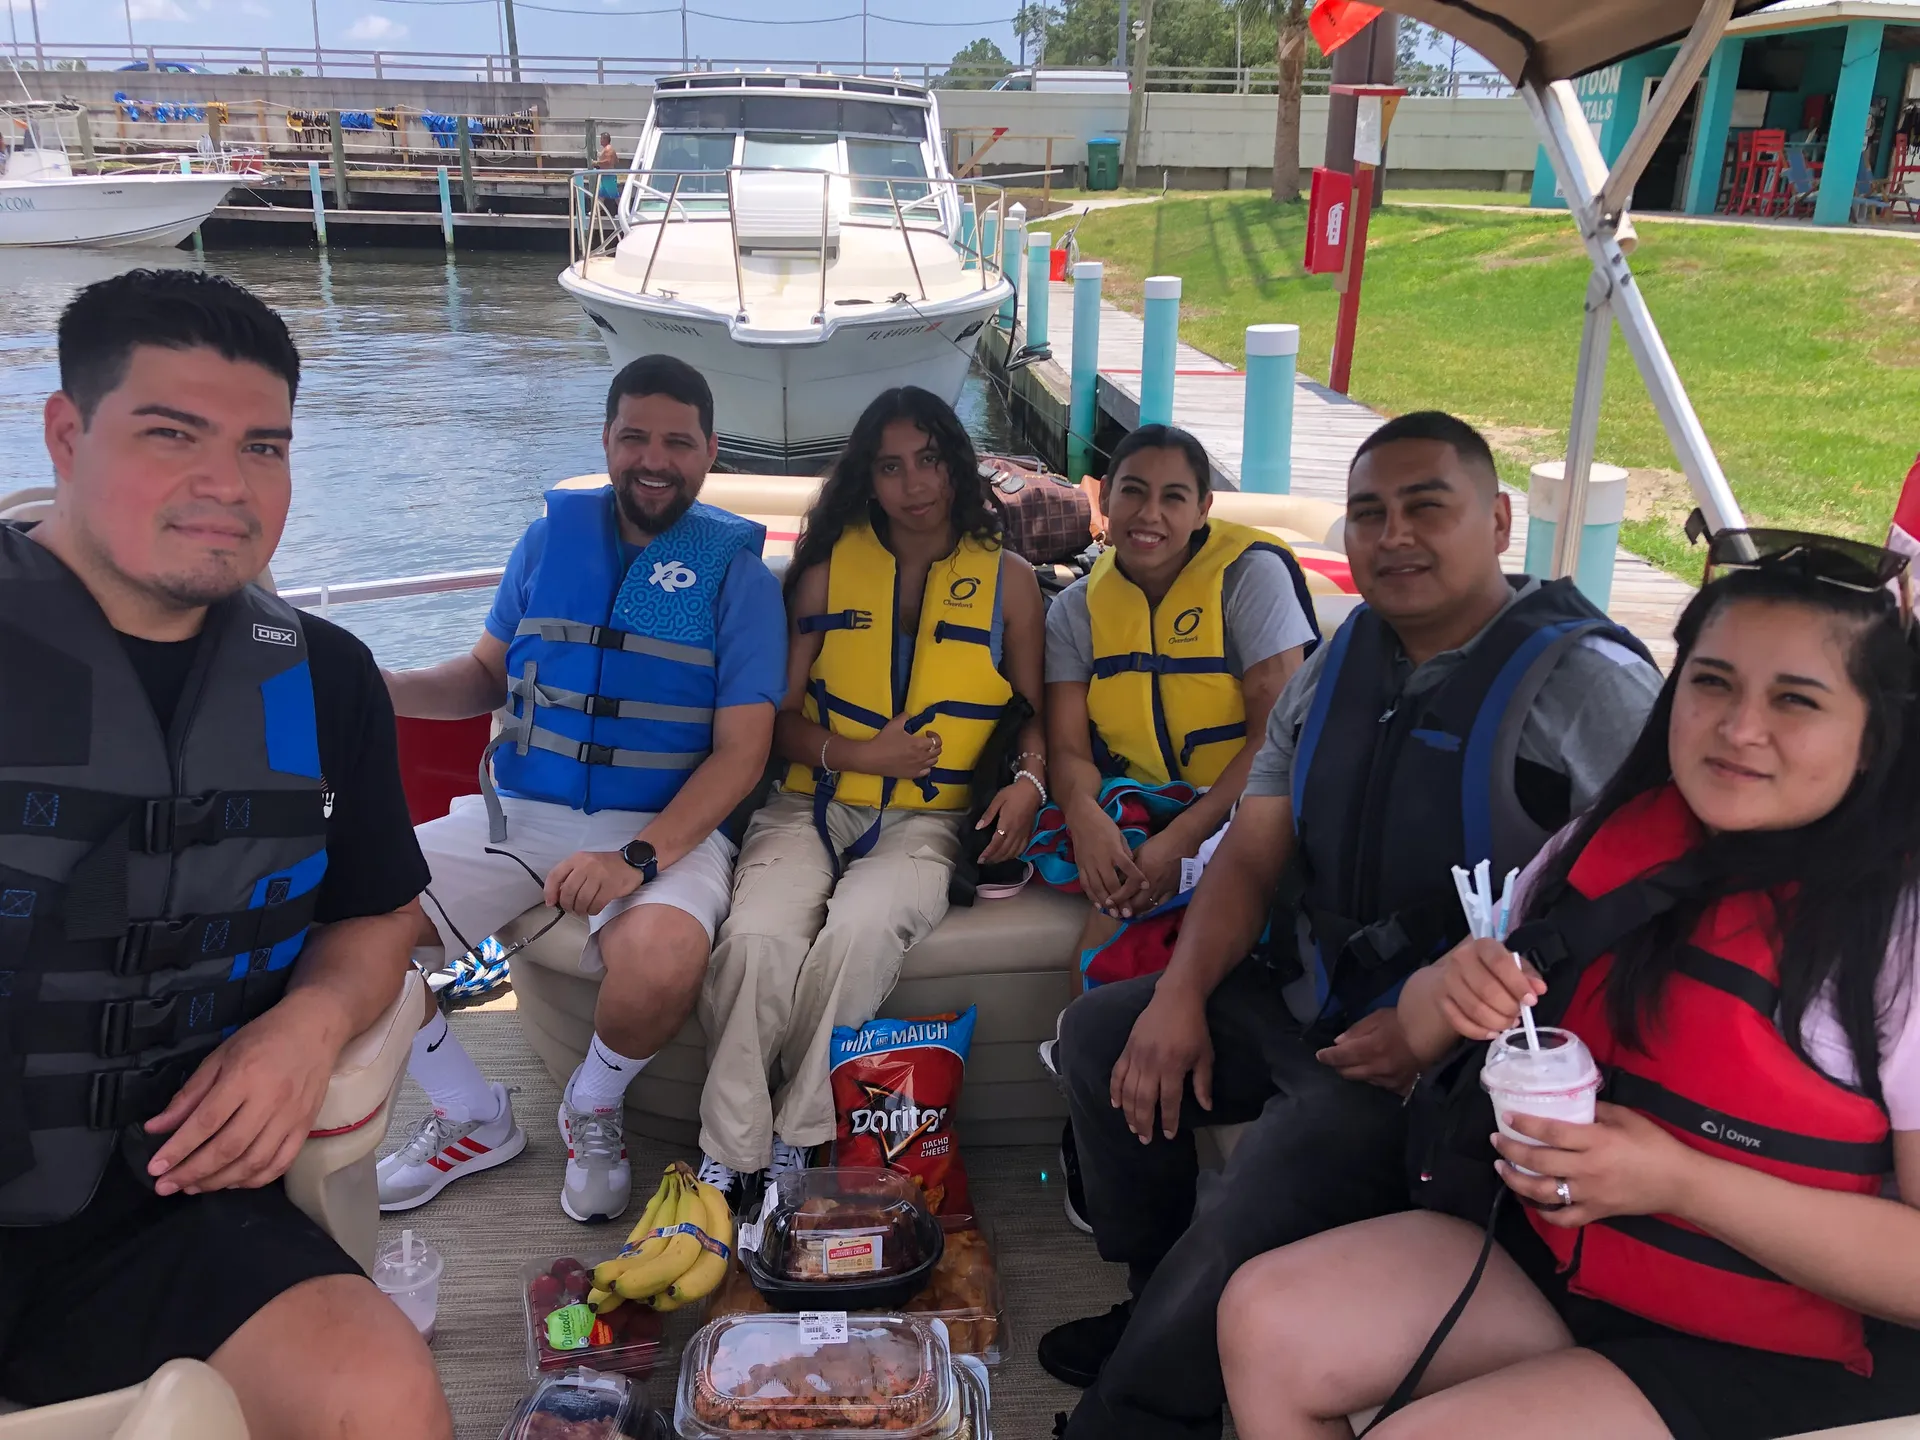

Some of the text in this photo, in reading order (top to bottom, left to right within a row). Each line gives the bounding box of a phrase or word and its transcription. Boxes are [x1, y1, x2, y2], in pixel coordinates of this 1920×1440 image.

[257, 628, 293, 643] DBX
[891, 1021, 948, 1045] MATCH
[922, 1136, 949, 1150] NACHO
[1726, 1129, 1762, 1148] Onyx
[920, 1144, 949, 1158] CHEESE
